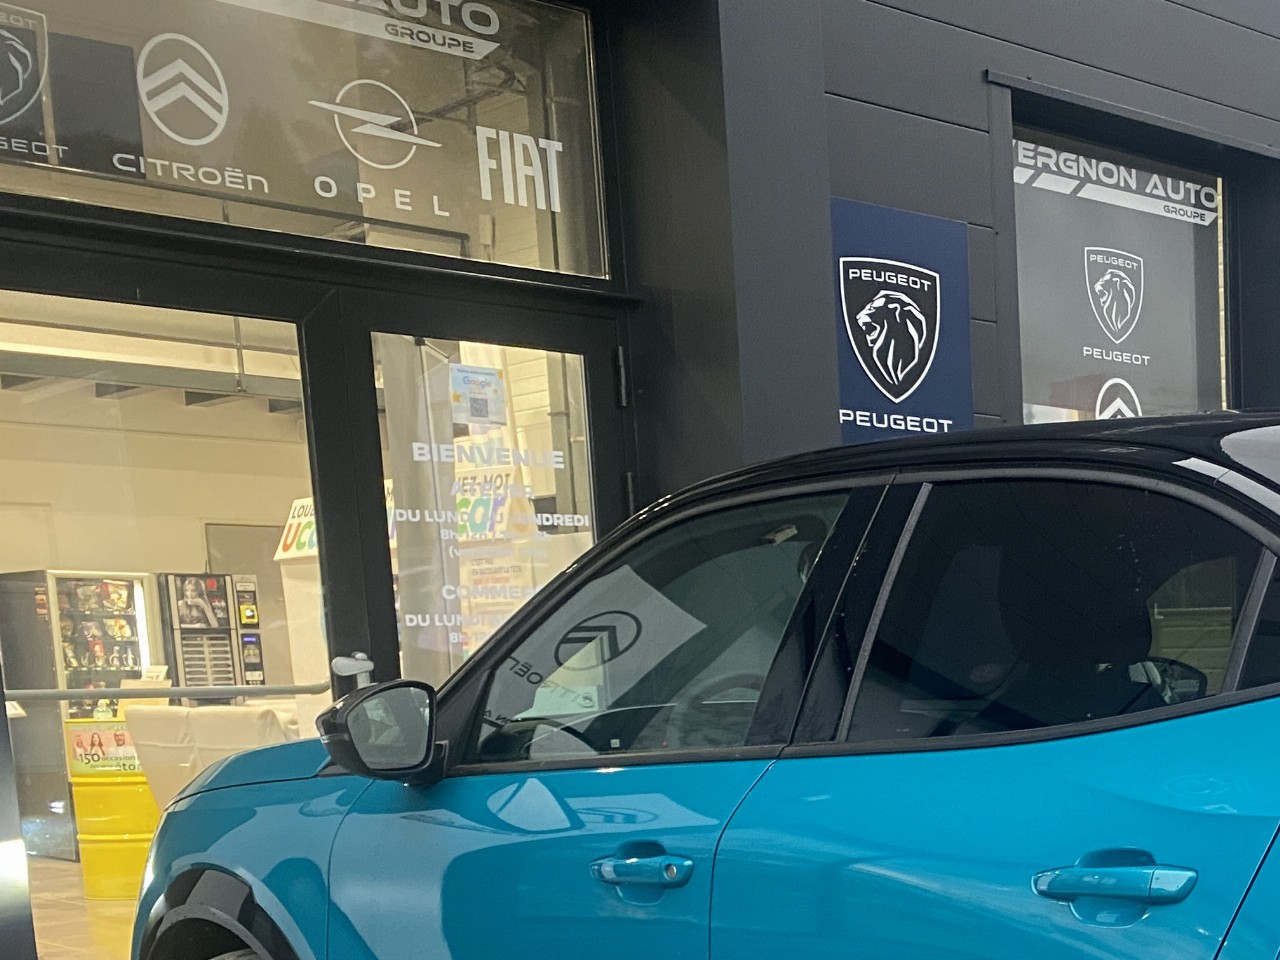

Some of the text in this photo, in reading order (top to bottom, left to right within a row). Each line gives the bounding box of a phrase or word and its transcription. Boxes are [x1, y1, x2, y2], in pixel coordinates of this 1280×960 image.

[385, 22, 475, 53] GROUPE
[475, 125, 563, 212] FIAT
[1012, 139, 1218, 209] ERGNON AUTO
[314, 175, 450, 217] OPEL
[1163, 204, 1207, 222] GROUPE
[1089, 254, 1139, 270] PEUGEOT
[848, 268, 932, 292] PEUGEOT
[1083, 346, 1151, 366] PEUGEOT
[839, 409, 953, 433] PEUGEOT
[412, 441, 566, 470] BIENVENUE
[395, 509, 421, 522] DU
[405, 614, 430, 627] DU
[78, 752, 101, 765] 150
